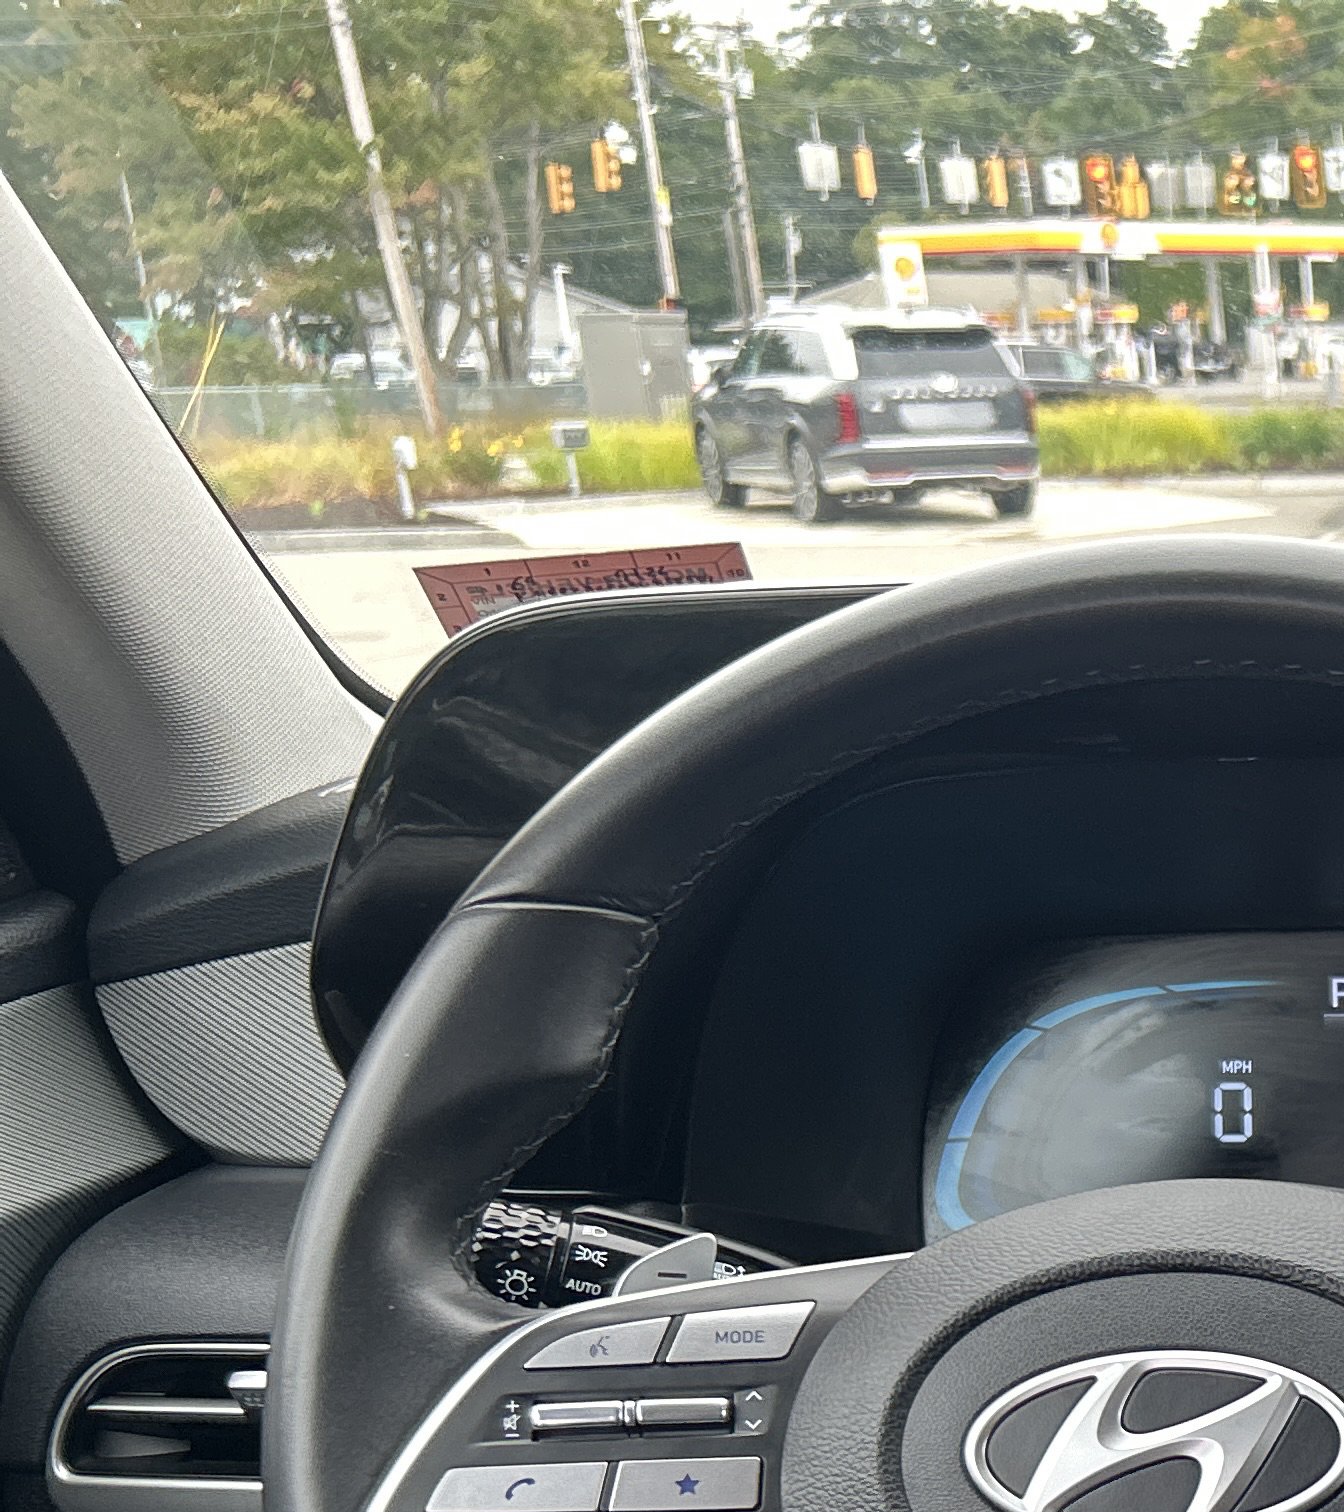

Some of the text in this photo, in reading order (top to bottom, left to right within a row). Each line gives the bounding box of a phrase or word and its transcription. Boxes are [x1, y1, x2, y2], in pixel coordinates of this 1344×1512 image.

[1222, 1060, 1252, 1073] MPH
[1214, 1082, 1252, 1142] 0
[565, 1279, 601, 1295] AUTO
[715, 1330, 764, 1343] MODE
